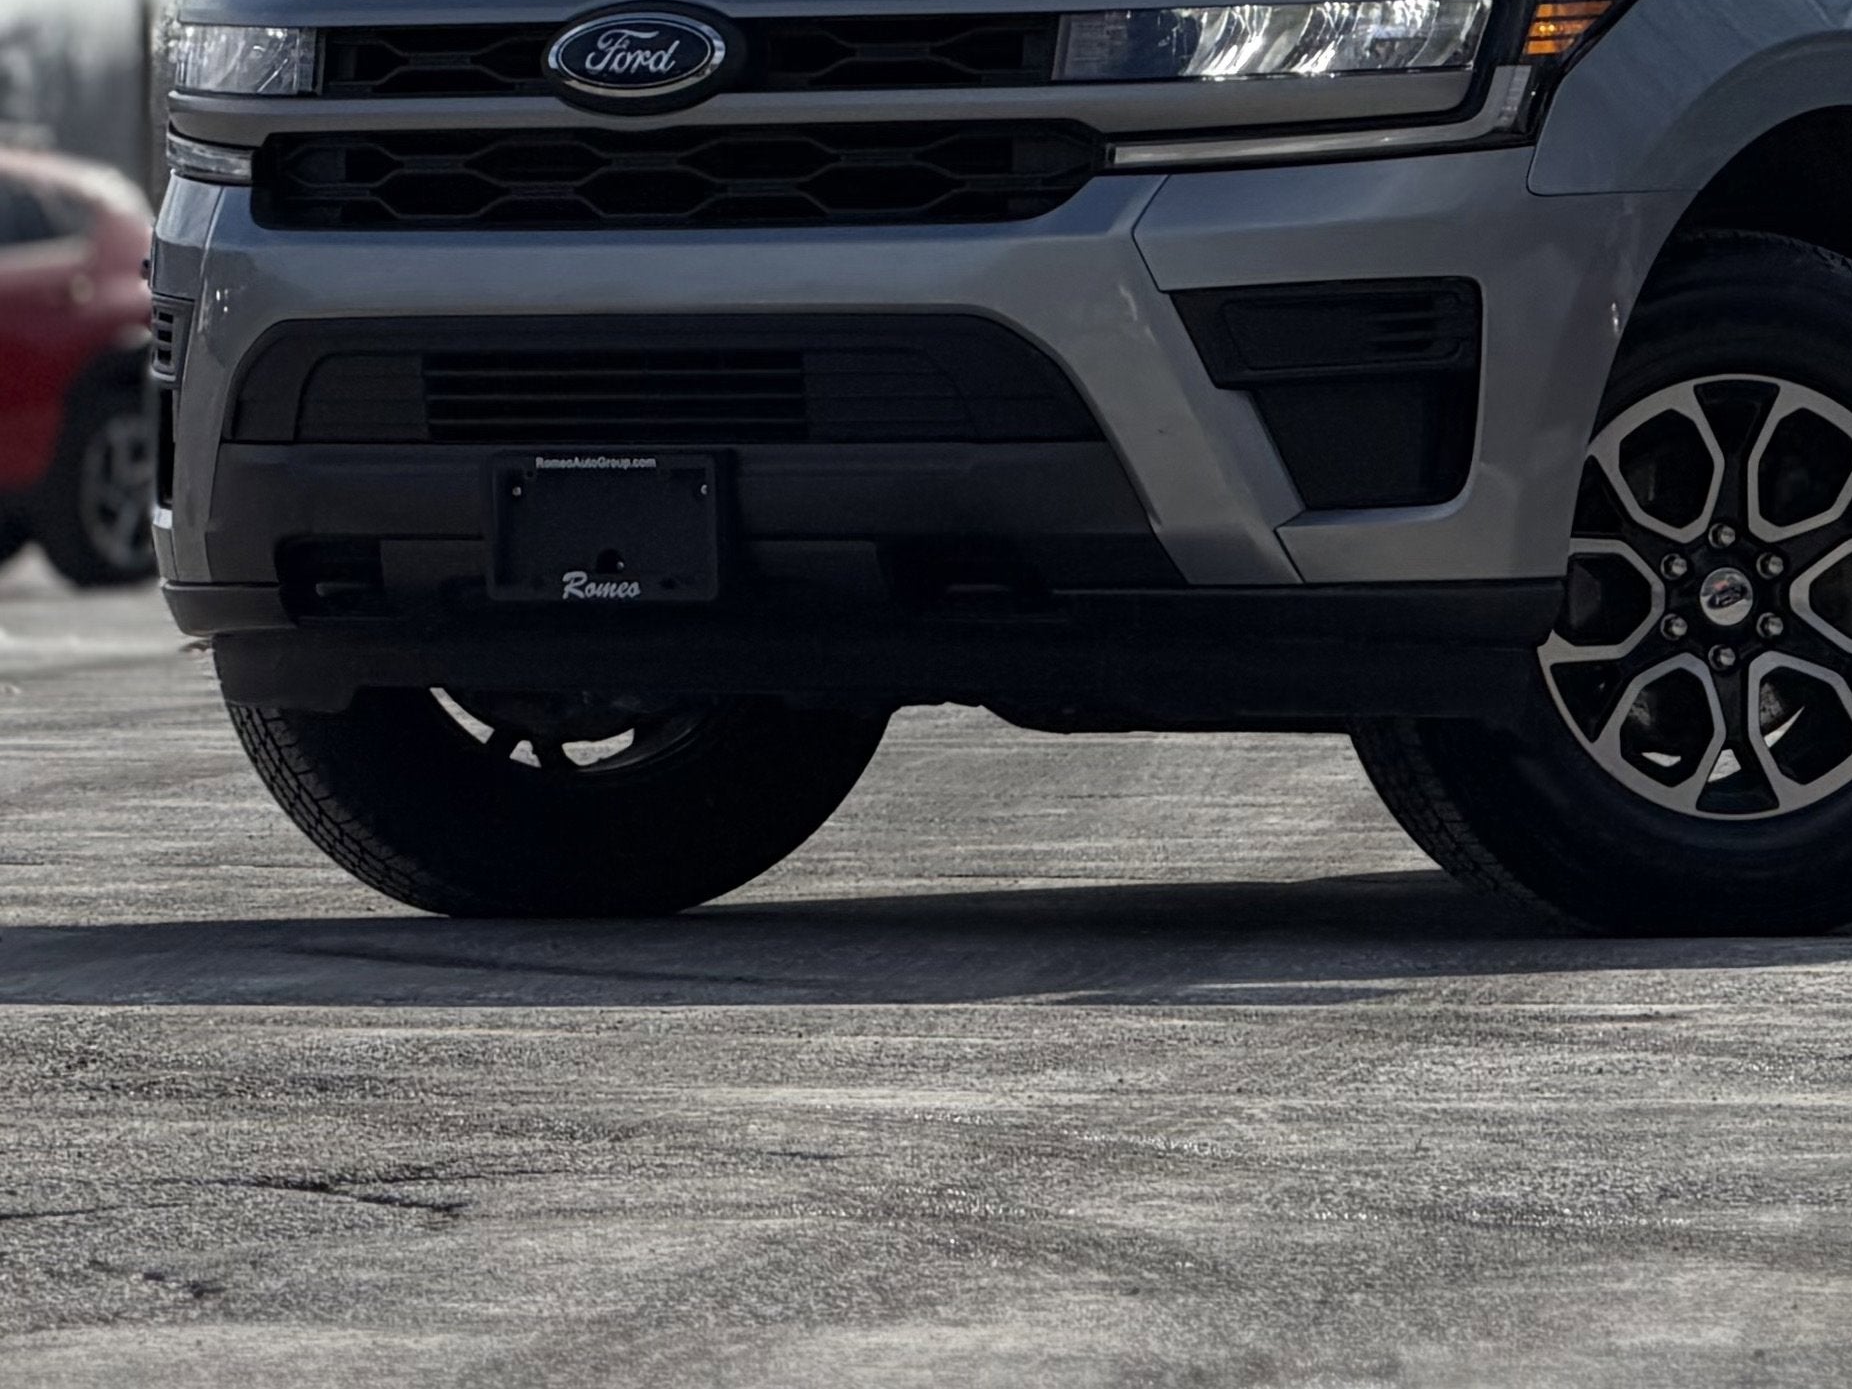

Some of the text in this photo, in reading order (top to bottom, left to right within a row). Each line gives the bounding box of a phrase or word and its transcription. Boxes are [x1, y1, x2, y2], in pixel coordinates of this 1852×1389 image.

[585, 29, 680, 74] Ford
[535, 456, 656, 470] RomeoAutoGroup.com
[562, 570, 641, 599] Romeo
